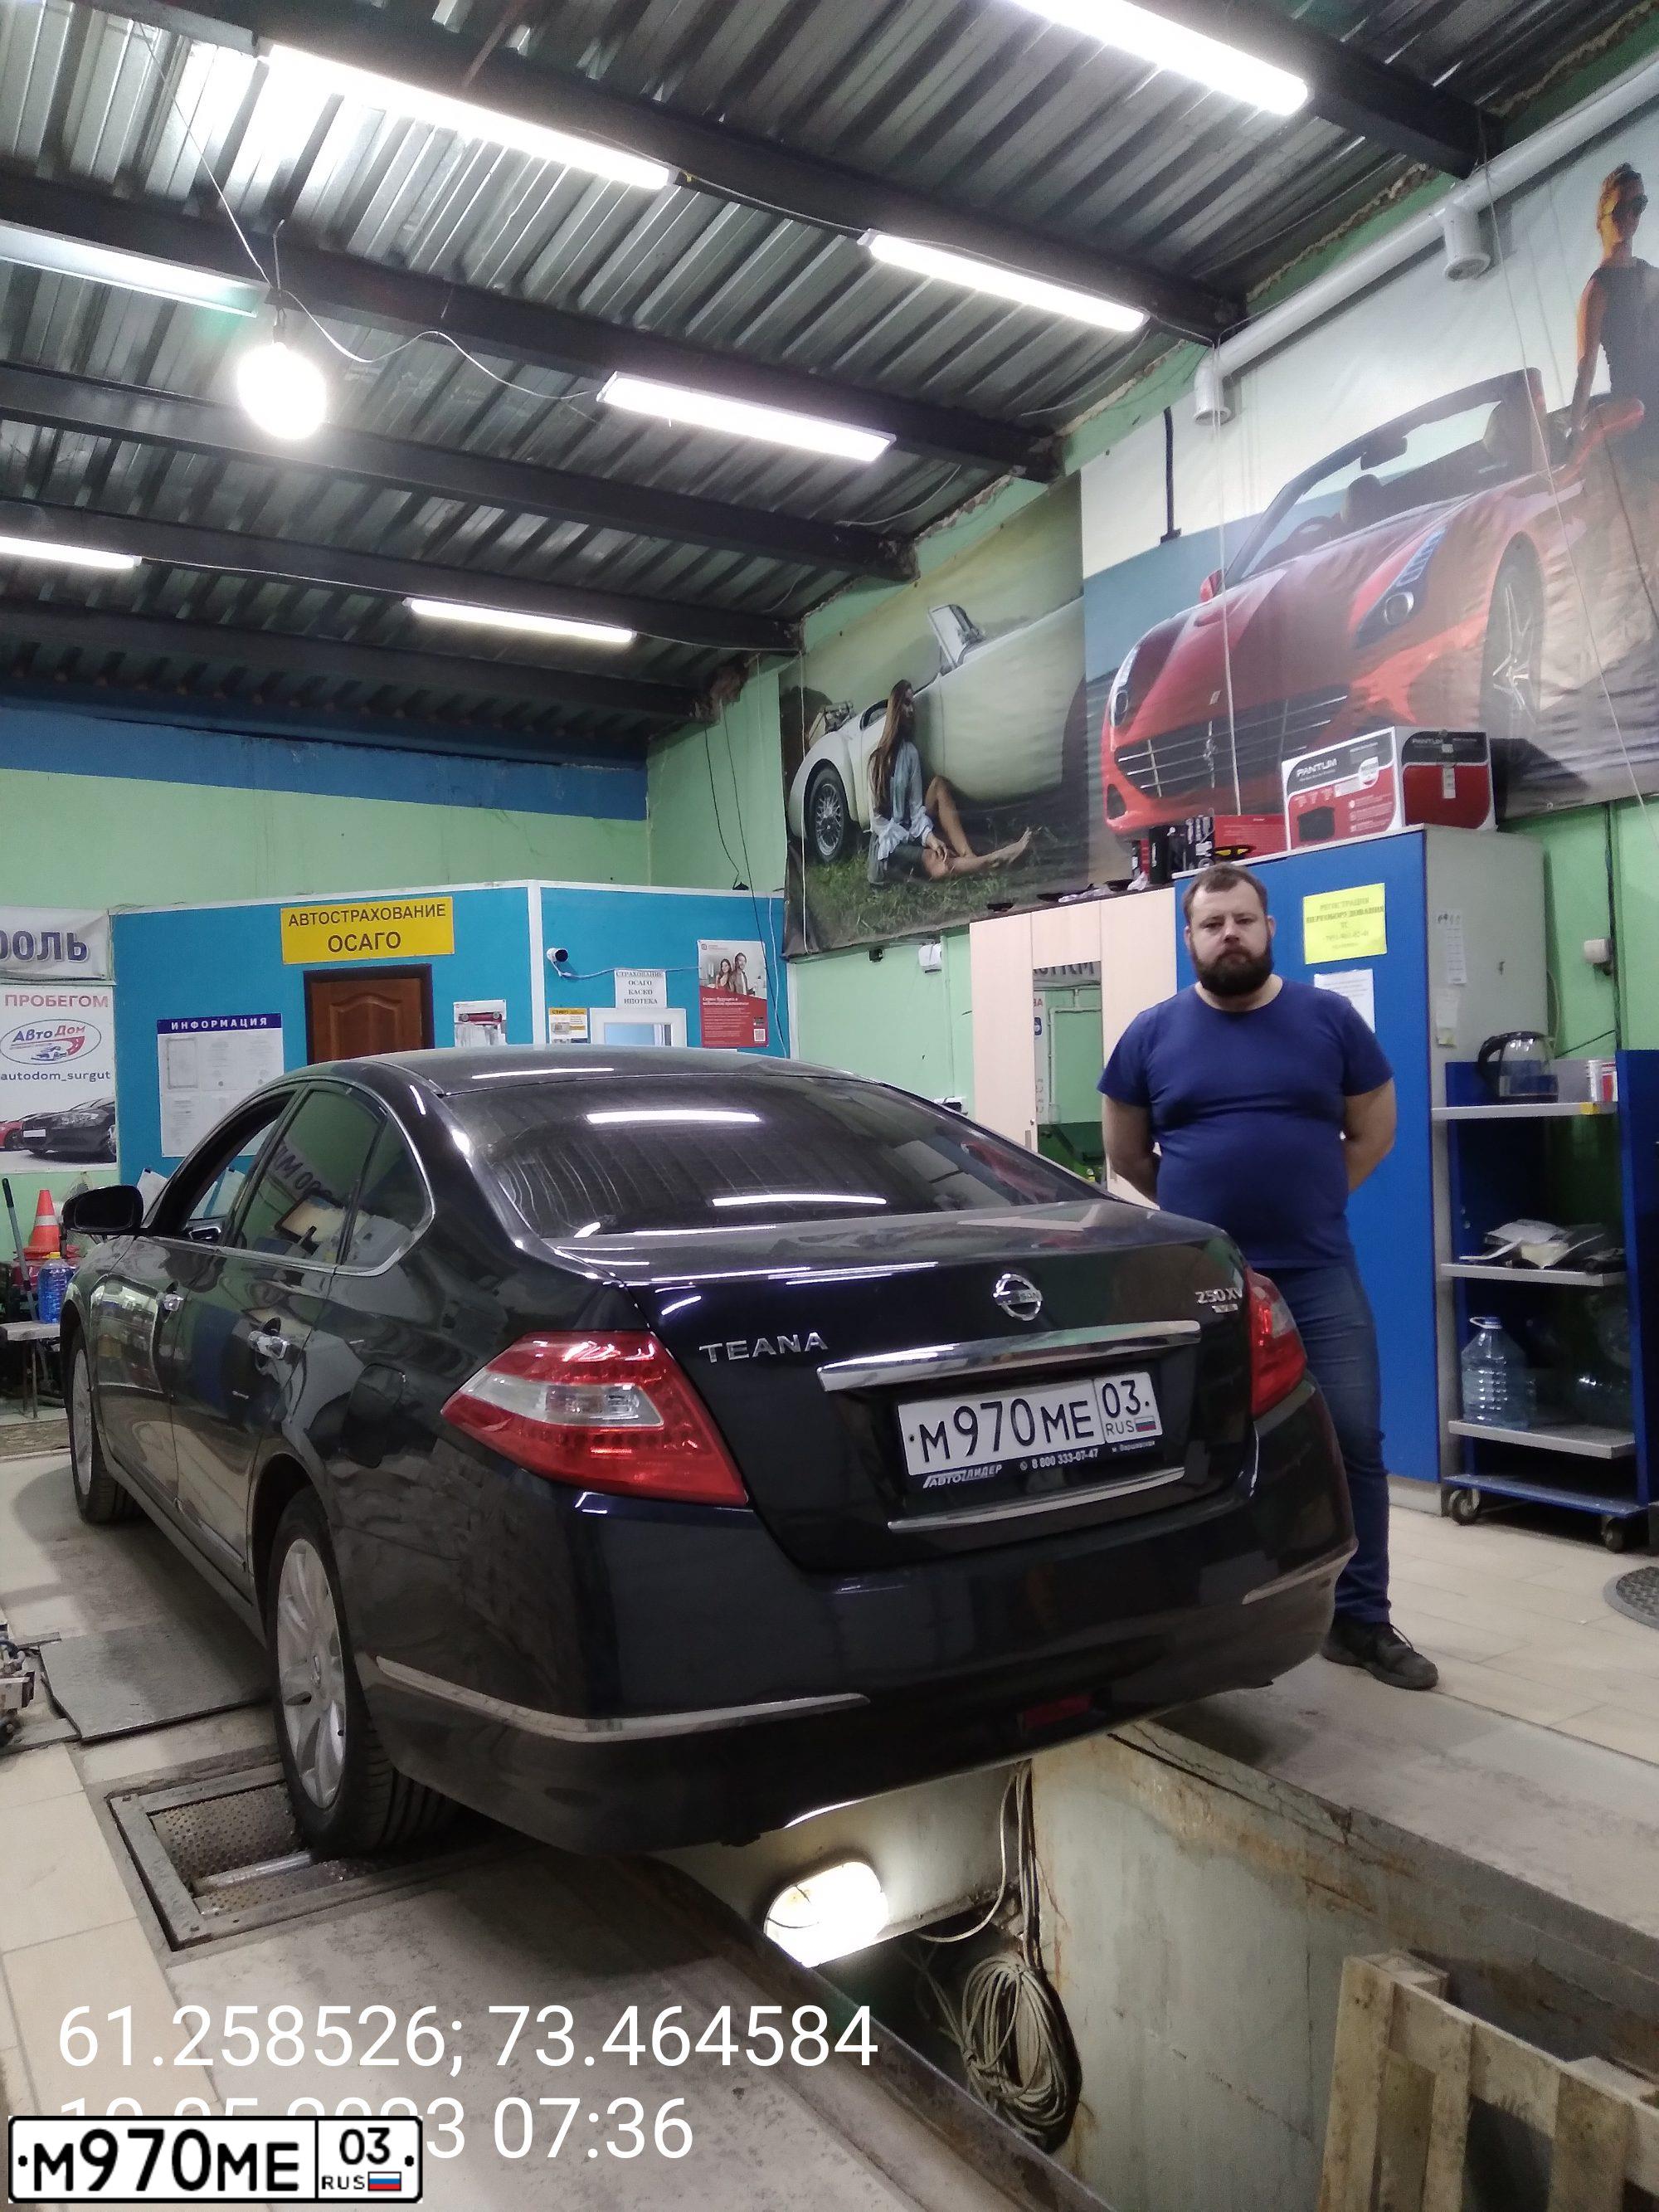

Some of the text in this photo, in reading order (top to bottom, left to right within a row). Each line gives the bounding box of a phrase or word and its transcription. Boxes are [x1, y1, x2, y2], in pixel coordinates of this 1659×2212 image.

[1297, 758, 1337, 777] PANTUM
[289, 904, 446, 928] АВТОСТРАХОВАНИЕ
[328, 931, 401, 953] ОСАГО
[4, 994, 109, 1008] ПРОБЕГОМ
[171, 1017, 268, 1030] ИНФОРМАЦИЯ
[0, 1070, 110, 1083] autodom_surgut
[699, 1332, 829, 1364] TEANA
[1102, 1380, 1141, 1418] 03
[918, 1398, 1094, 1463] М970МЕ
[1105, 1423, 1135, 1435] RUS
